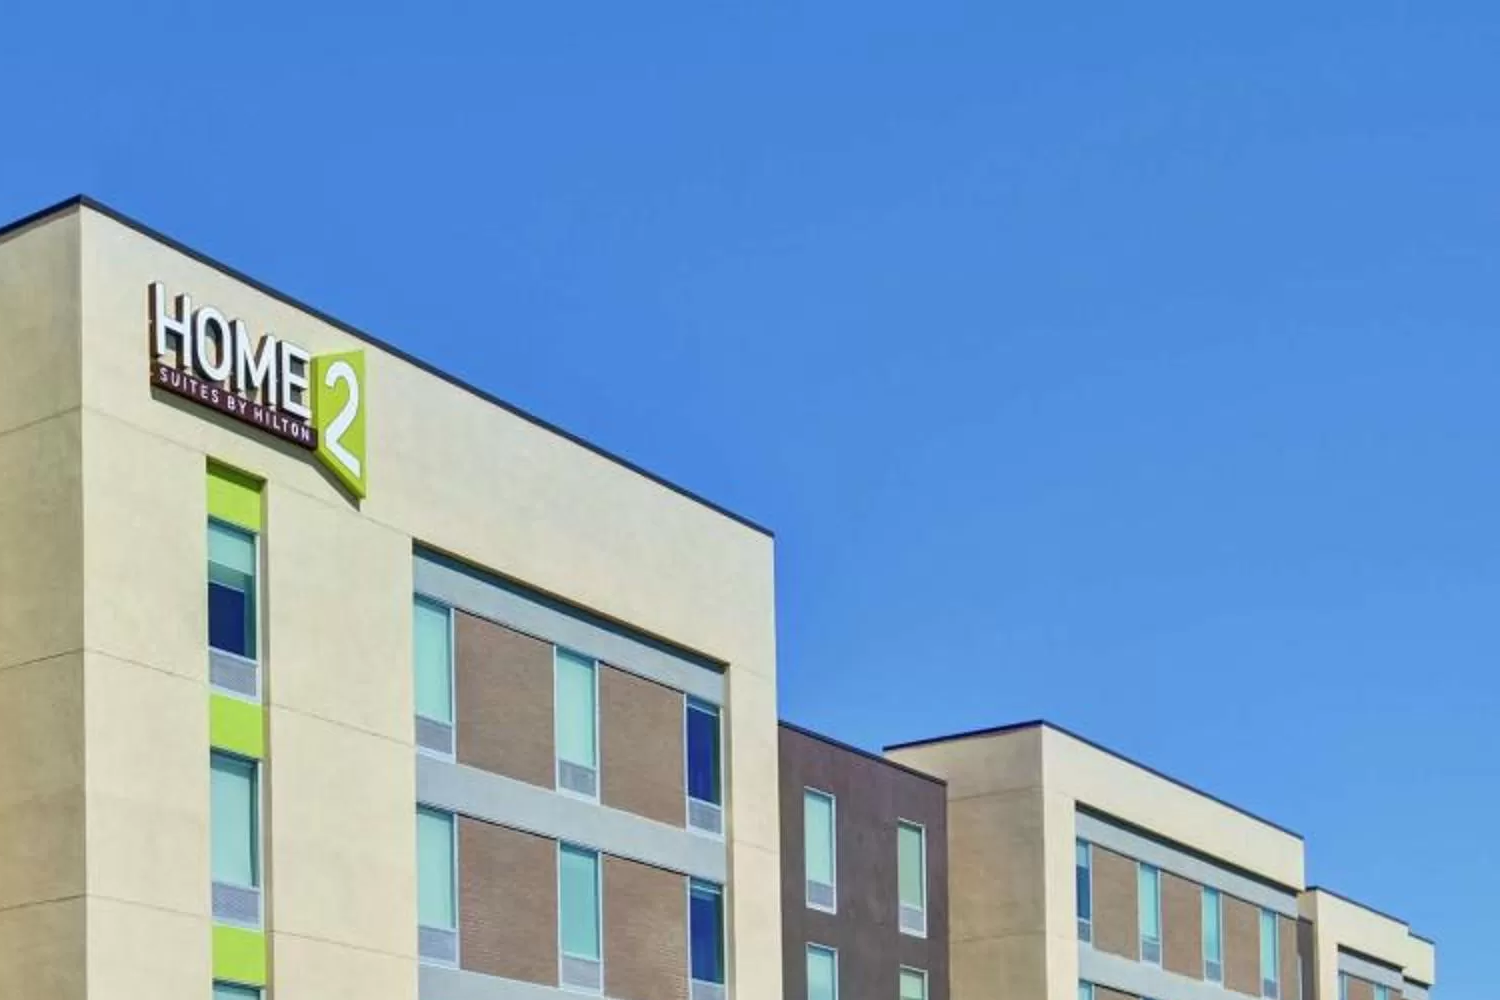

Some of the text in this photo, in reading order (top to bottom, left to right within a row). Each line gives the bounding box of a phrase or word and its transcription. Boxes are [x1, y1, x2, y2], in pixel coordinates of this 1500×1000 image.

[151, 281, 361, 480] HOME 2
[158, 367, 311, 442] SUITES BY HILTON
